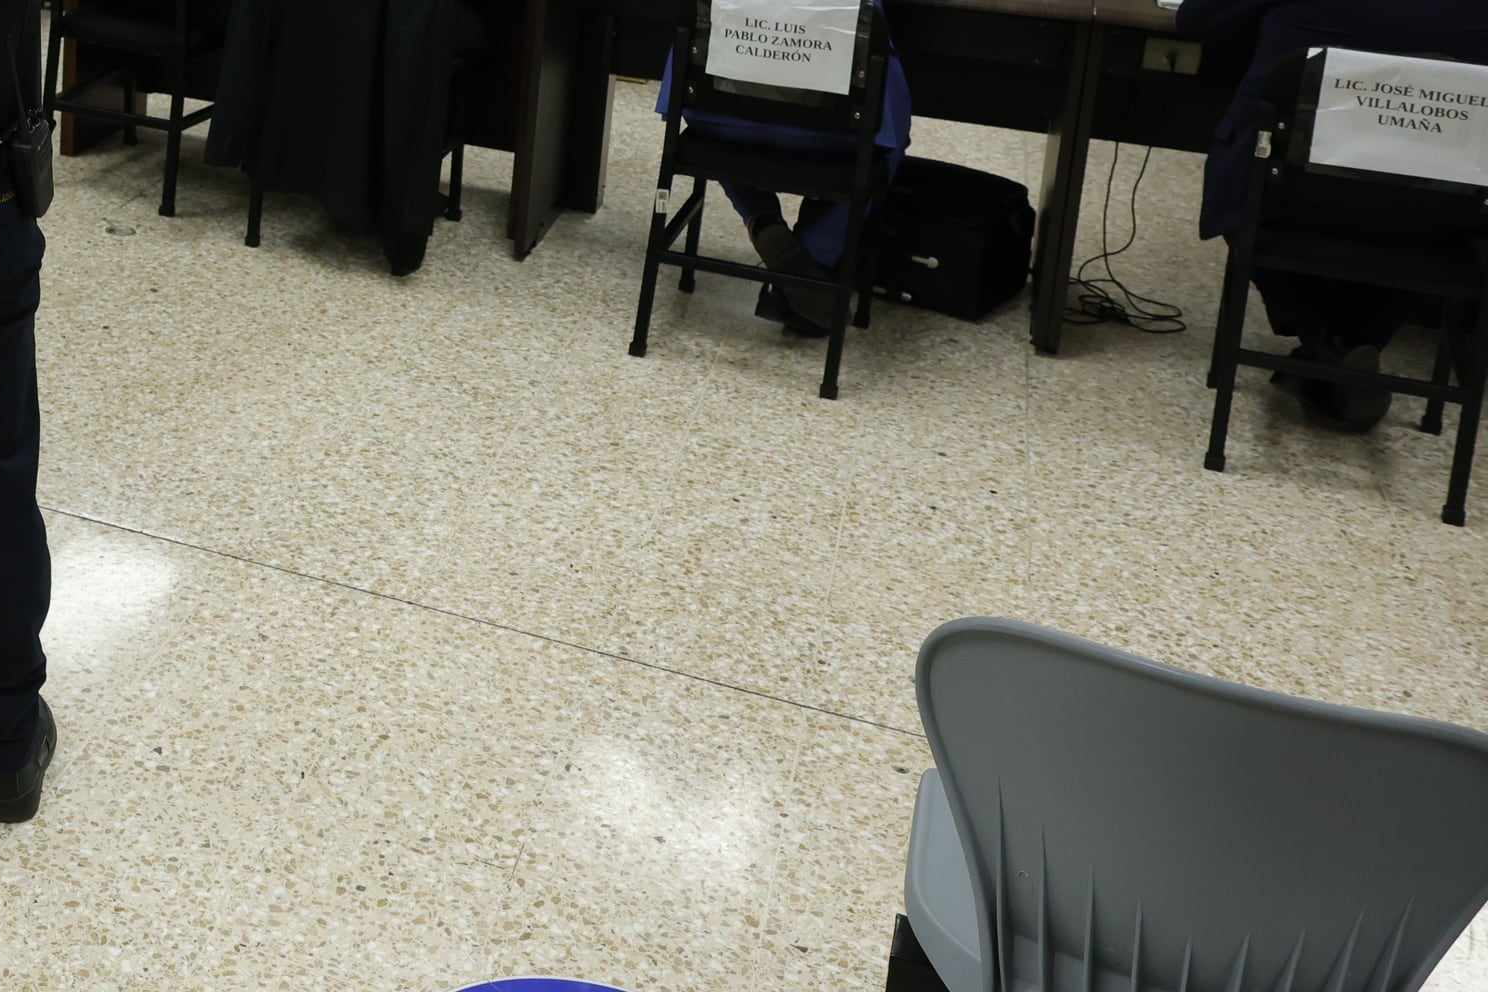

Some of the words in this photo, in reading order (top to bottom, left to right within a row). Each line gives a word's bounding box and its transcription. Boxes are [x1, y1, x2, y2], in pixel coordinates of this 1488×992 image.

[745, 17, 771, 30] LIC.
[775, 21, 806, 34] LUIS
[724, 28, 768, 44] PABLO
[771, 36, 833, 51] ZAMORA
[735, 44, 812, 62] CALDERÓN
[1334, 78, 1367, 91] LIC.
[1371, 82, 1414, 97] JOSÉ
[1419, 89, 1488, 108] MIGUEL
[1356, 95, 1469, 120] VILLALOBOS
[1377, 114, 1442, 133] UMAÑA
